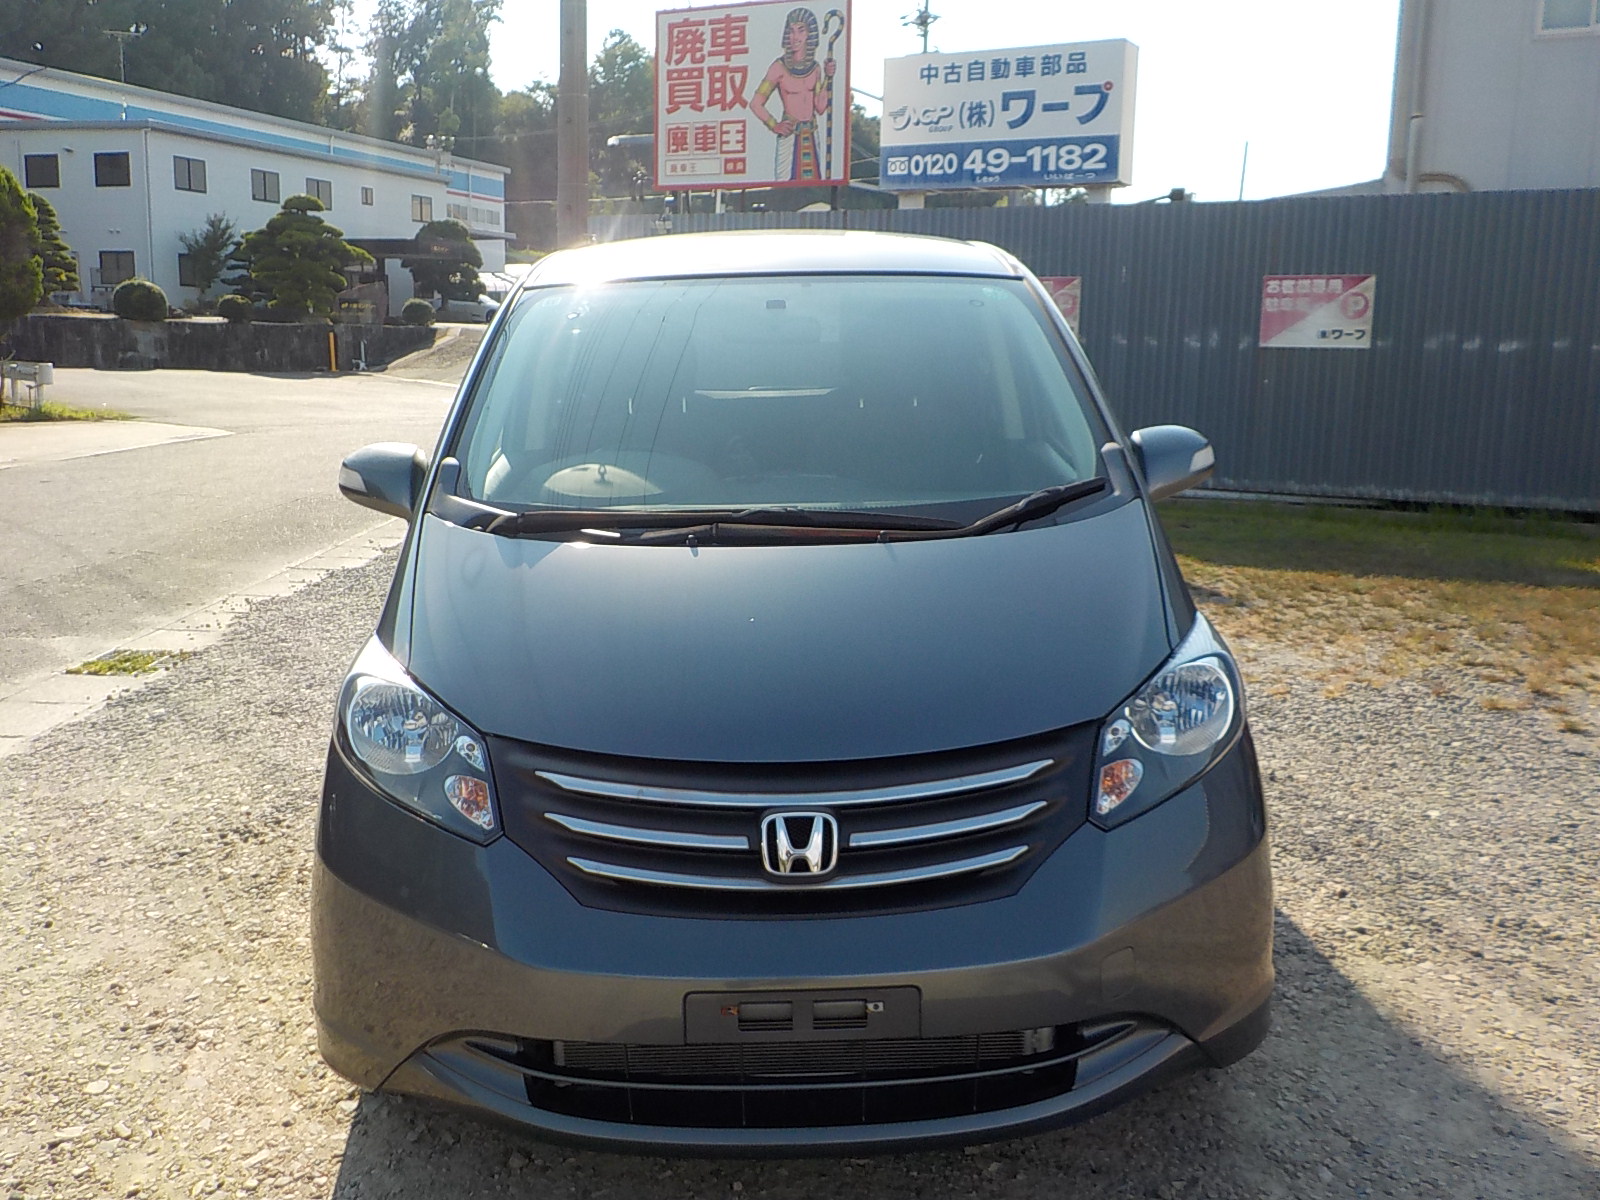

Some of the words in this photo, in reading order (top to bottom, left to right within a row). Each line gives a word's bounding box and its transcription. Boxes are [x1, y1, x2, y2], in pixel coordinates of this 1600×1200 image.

[665, 13, 749, 66] 廃車
[665, 64, 749, 115] 買取
[919, 52, 1088, 85] 中古自動車部品
[910, 153, 958, 176] 0120
[963, 143, 1108, 174] 49-1182
